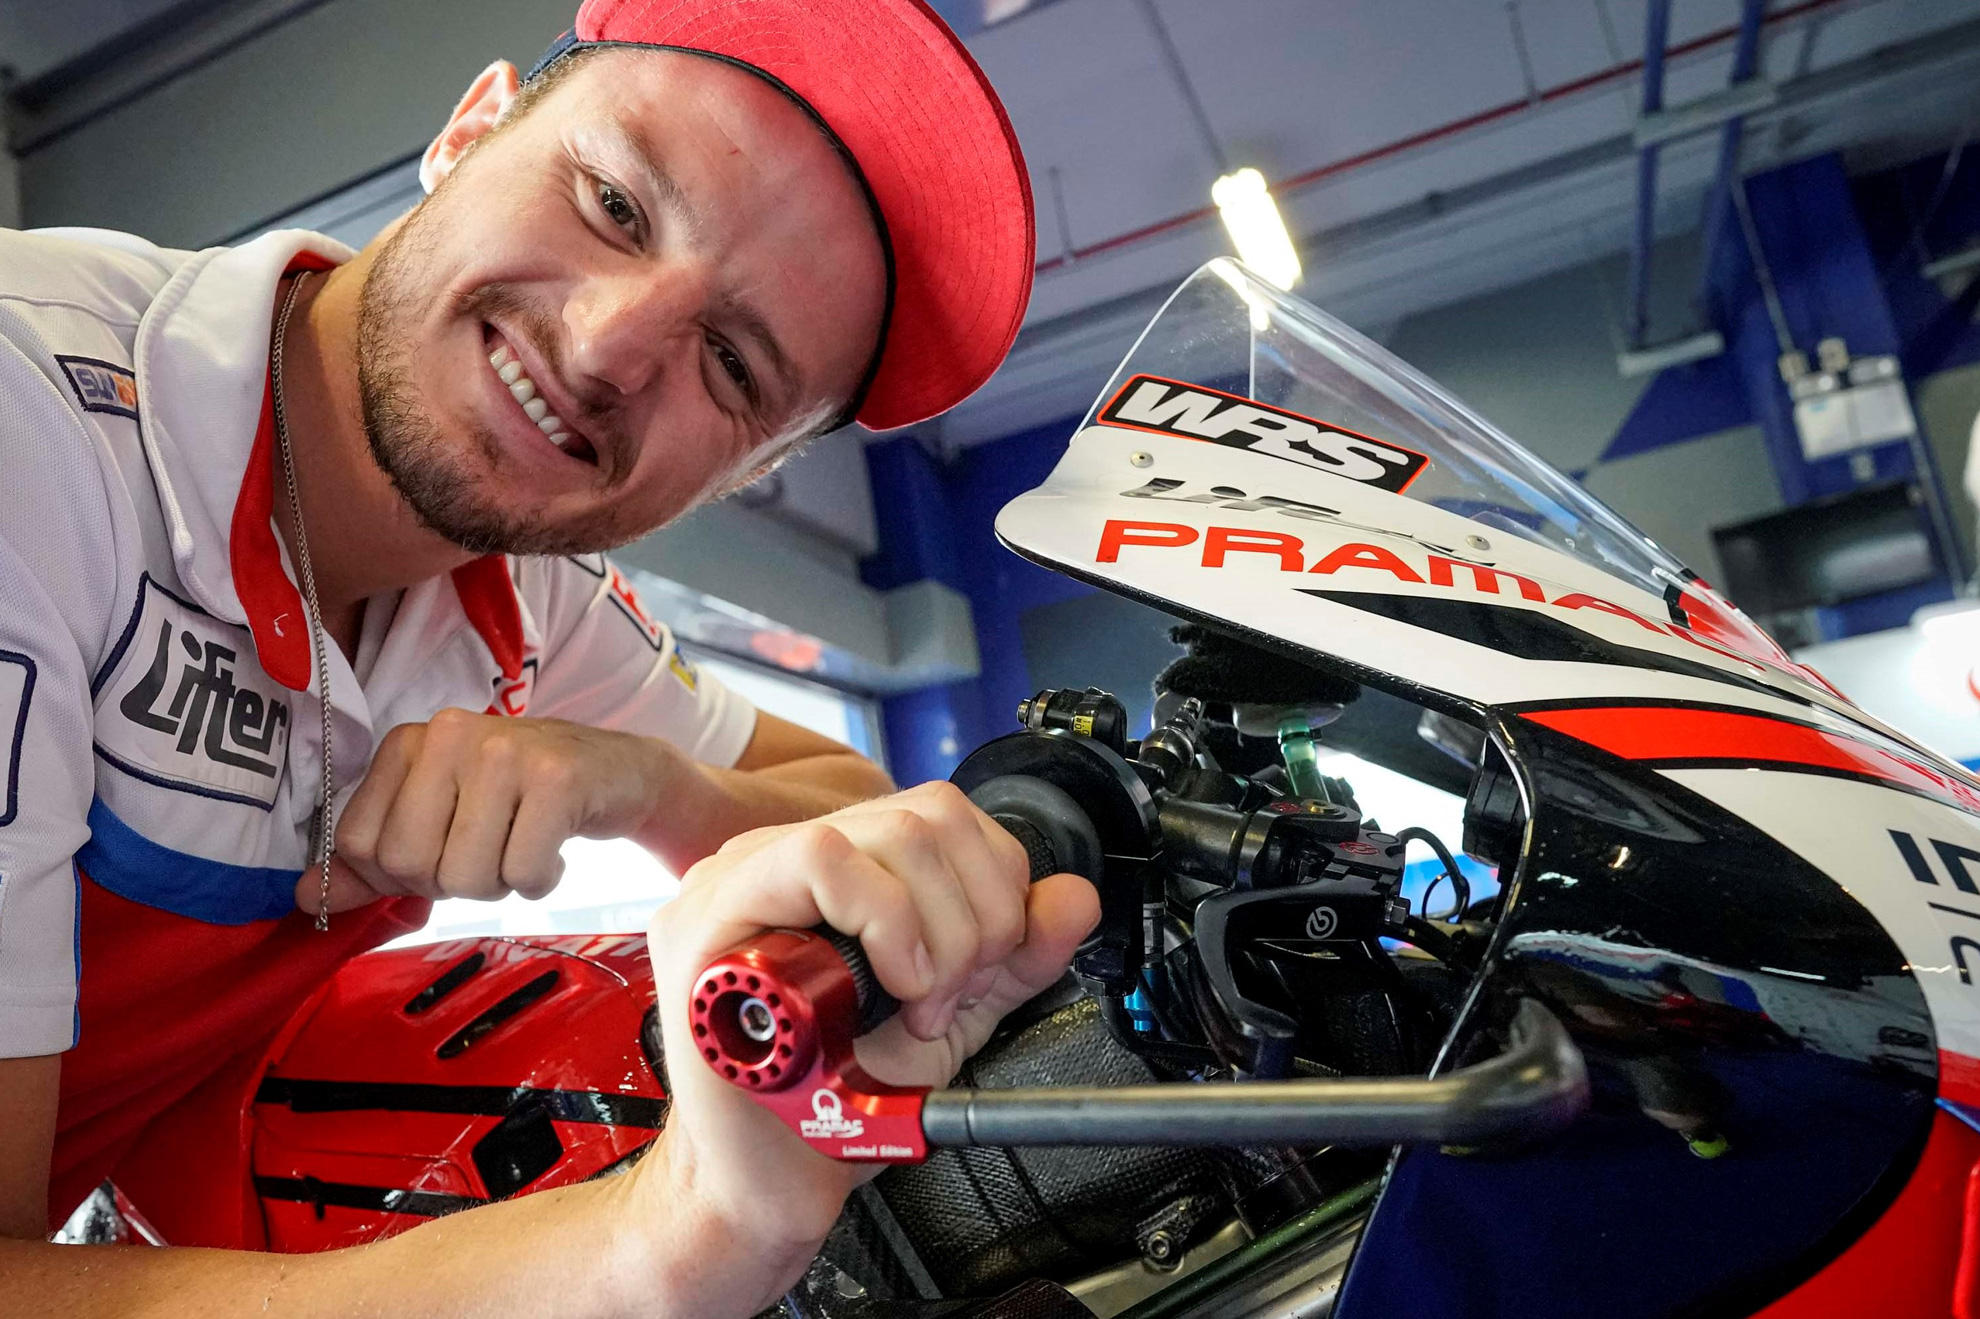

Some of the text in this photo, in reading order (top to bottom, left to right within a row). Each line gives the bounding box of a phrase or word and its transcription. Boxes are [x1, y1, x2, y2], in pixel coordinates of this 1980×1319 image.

[1115, 381, 1409, 481] WRS
[120, 618, 288, 779] Lifter
[842, 1144, 913, 1157] Limited Edition
